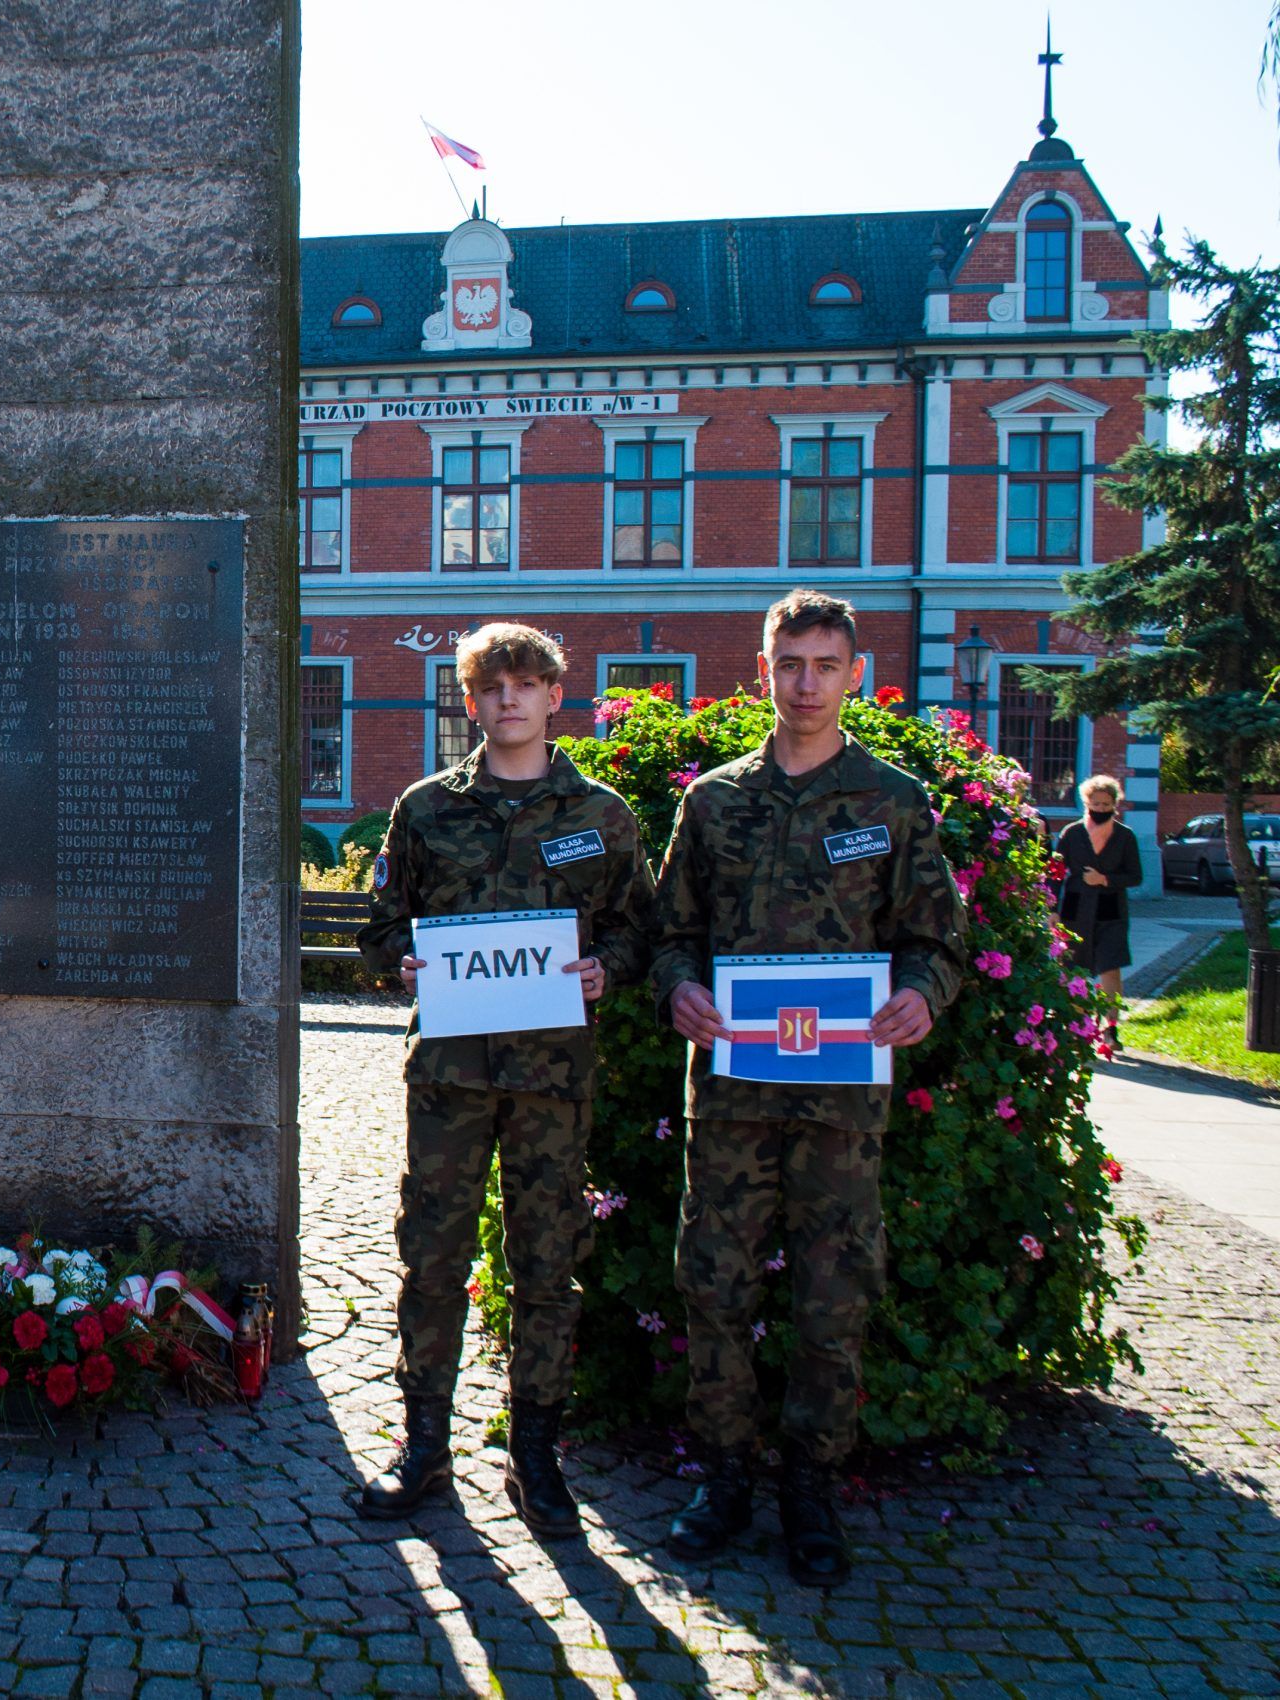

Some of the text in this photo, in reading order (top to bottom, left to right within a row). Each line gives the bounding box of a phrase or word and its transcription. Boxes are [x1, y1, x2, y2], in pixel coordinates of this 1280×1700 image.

[300, 404, 365, 421] URZĄD
[381, 400, 488, 418] POCZTOWY
[506, 394, 593, 414] ŚWIECIE
[55, 533, 110, 552] JEST
[103, 601, 210, 620] OFIAROM
[34, 622, 81, 640] 1939
[58, 667, 172, 680] OSSOWSKI IZYDOR
[58, 684, 216, 699] OSTROWSKI FRANCISZEK
[126, 701, 209, 715] FRANCISZEK
[58, 717, 216, 732] POZORSKA STANISŁAWA
[58, 734, 189, 749] PRYCZKOWSKI LEON
[58, 751, 164, 765] PUDEŁKO PAWEŁ
[57, 768, 201, 783] SKRZYPCZAK MICHAŁ
[57, 785, 191, 799] SKUBAŁA WALENTY
[57, 801, 179, 816] SOŁTYSIK DOMINIK
[57, 818, 214, 833] SUCHALSKI STANISŁAW
[57, 835, 198, 850] SUCHORSKI KSAWERY
[558, 837, 584, 850] KLASA
[844, 833, 874, 846] KLASA
[548, 843, 600, 861] MUNDUROWA
[832, 840, 888, 857] MUNDUROWA
[56, 852, 208, 867] SZOFFER MIECZYSŁAW
[160, 870, 214, 885] BRUNON
[155, 887, 206, 901] JULIAN
[126, 903, 179, 917] ALFONS
[148, 920, 179, 935] JAN
[56, 952, 193, 968] WŁOCH WŁADYSŁAW
[441, 946, 553, 981] TAMY
[55, 968, 153, 984] ZAREMBA JAN
